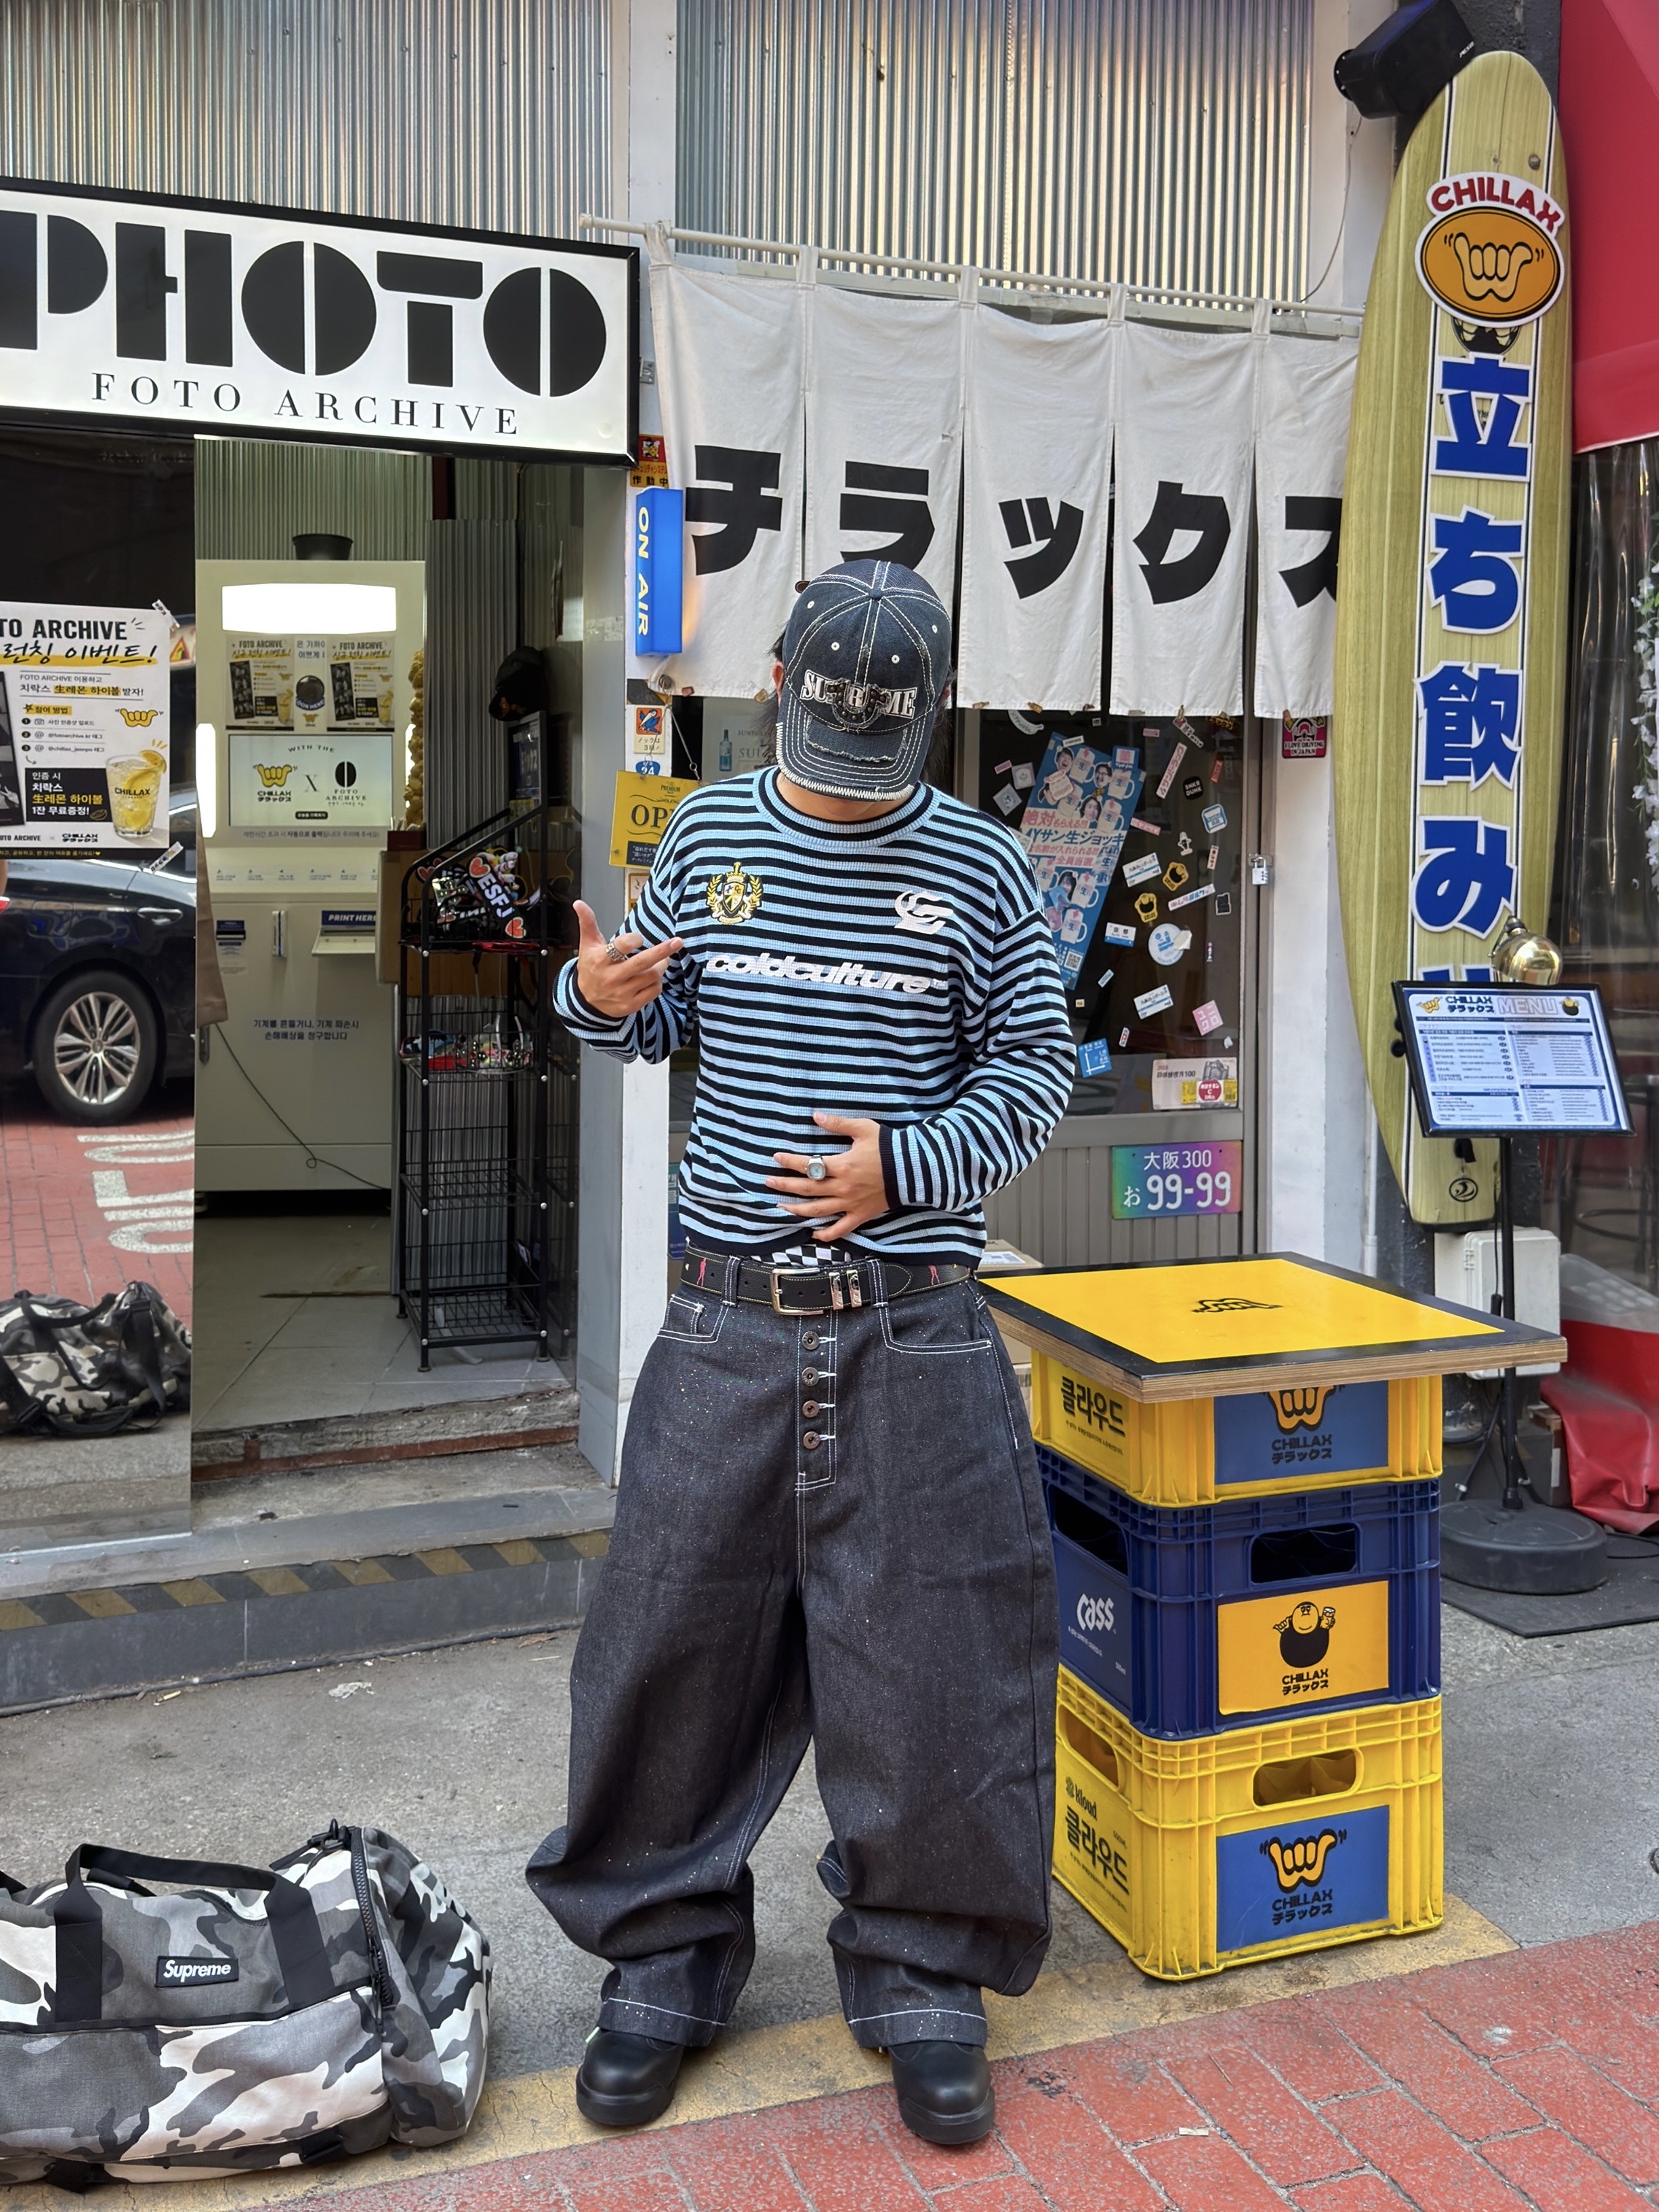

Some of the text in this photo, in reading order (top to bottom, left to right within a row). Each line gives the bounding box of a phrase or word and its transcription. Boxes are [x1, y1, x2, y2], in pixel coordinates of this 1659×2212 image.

[1431, 176, 1561, 233] CHILLAX
[0, 211, 607, 398] PHOTO
[90, 372, 518, 435] FOTO ARCHIVE
[638, 506, 649, 636] ON AIR
[32, 618, 128, 640] ARCHIVE
[65, 643, 158, 664] 이벤트!
[239, 640, 283, 649] FOTO ARCHIVE
[340, 643, 351, 651] FOTO
[1411, 356, 1531, 982] 立ち飲み
[41, 675, 72, 683] ARCHIVE
[20, 683, 51, 693] 치락스
[90, 686, 120, 696] 하이볼
[288, 745, 335, 753] WITH THE
[32, 772, 61, 781] 인증 시
[32, 783, 63, 793] 치락스
[114, 786, 151, 796] CHILLAX
[70, 794, 103, 805] 하이볼
[477, 872, 513, 918] ESFJ
[328, 914, 355, 922] PRINT
[705, 951, 930, 994] coldculture
[1445, 996, 1559, 1015] CHILLAX MENU
[1123, 1171, 1232, 1211] お 99-99
[1060, 1375, 1126, 1437] 클라우드
[1271, 1434, 1332, 1451] CHILLAX
[1271, 1448, 1332, 1466] チラックス
[1281, 1668, 1329, 1685] CHILLAX
[1281, 1678, 1329, 1696] チラックス
[1065, 1804, 1130, 1896] 클라우드
[1272, 1888, 1333, 1909] CHILLAX
[1272, 1902, 1333, 1926] チラックス
[163, 1959, 232, 1979] Supreme
